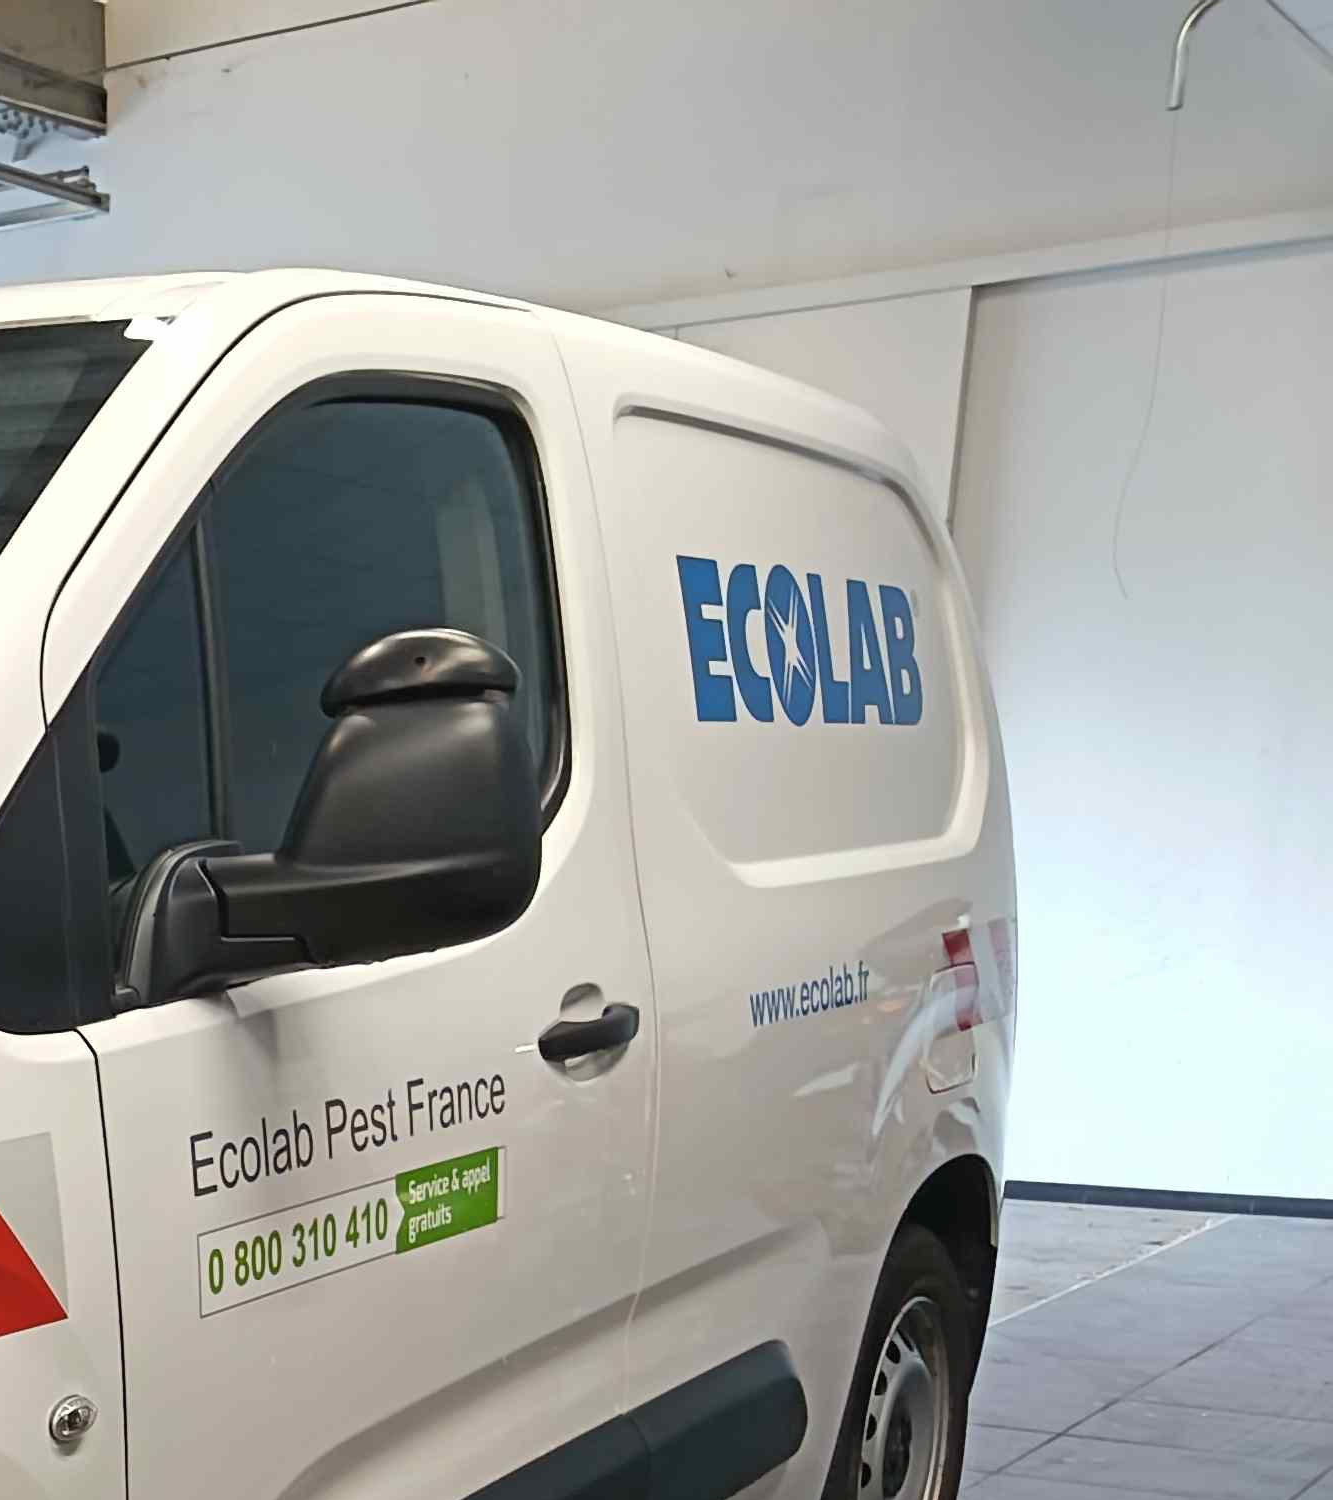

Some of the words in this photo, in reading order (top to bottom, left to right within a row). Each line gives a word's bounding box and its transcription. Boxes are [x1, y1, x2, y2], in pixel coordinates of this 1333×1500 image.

[676, 554, 924, 727] ECOLAB
[749, 960, 870, 1028] www.ecolab.fr
[189, 1109, 314, 1198] Ecolab
[324, 1087, 398, 1160] Pest
[406, 1073, 506, 1137] France
[408, 1173, 450, 1205] Service
[451, 1168, 460, 1192] &
[461, 1156, 491, 1195] appel
[208, 1248, 225, 1295] 0
[234, 1230, 283, 1287] 800
[291, 1213, 338, 1268] 310
[345, 1198, 389, 1249] 410
[408, 1203, 453, 1244] gratuits
